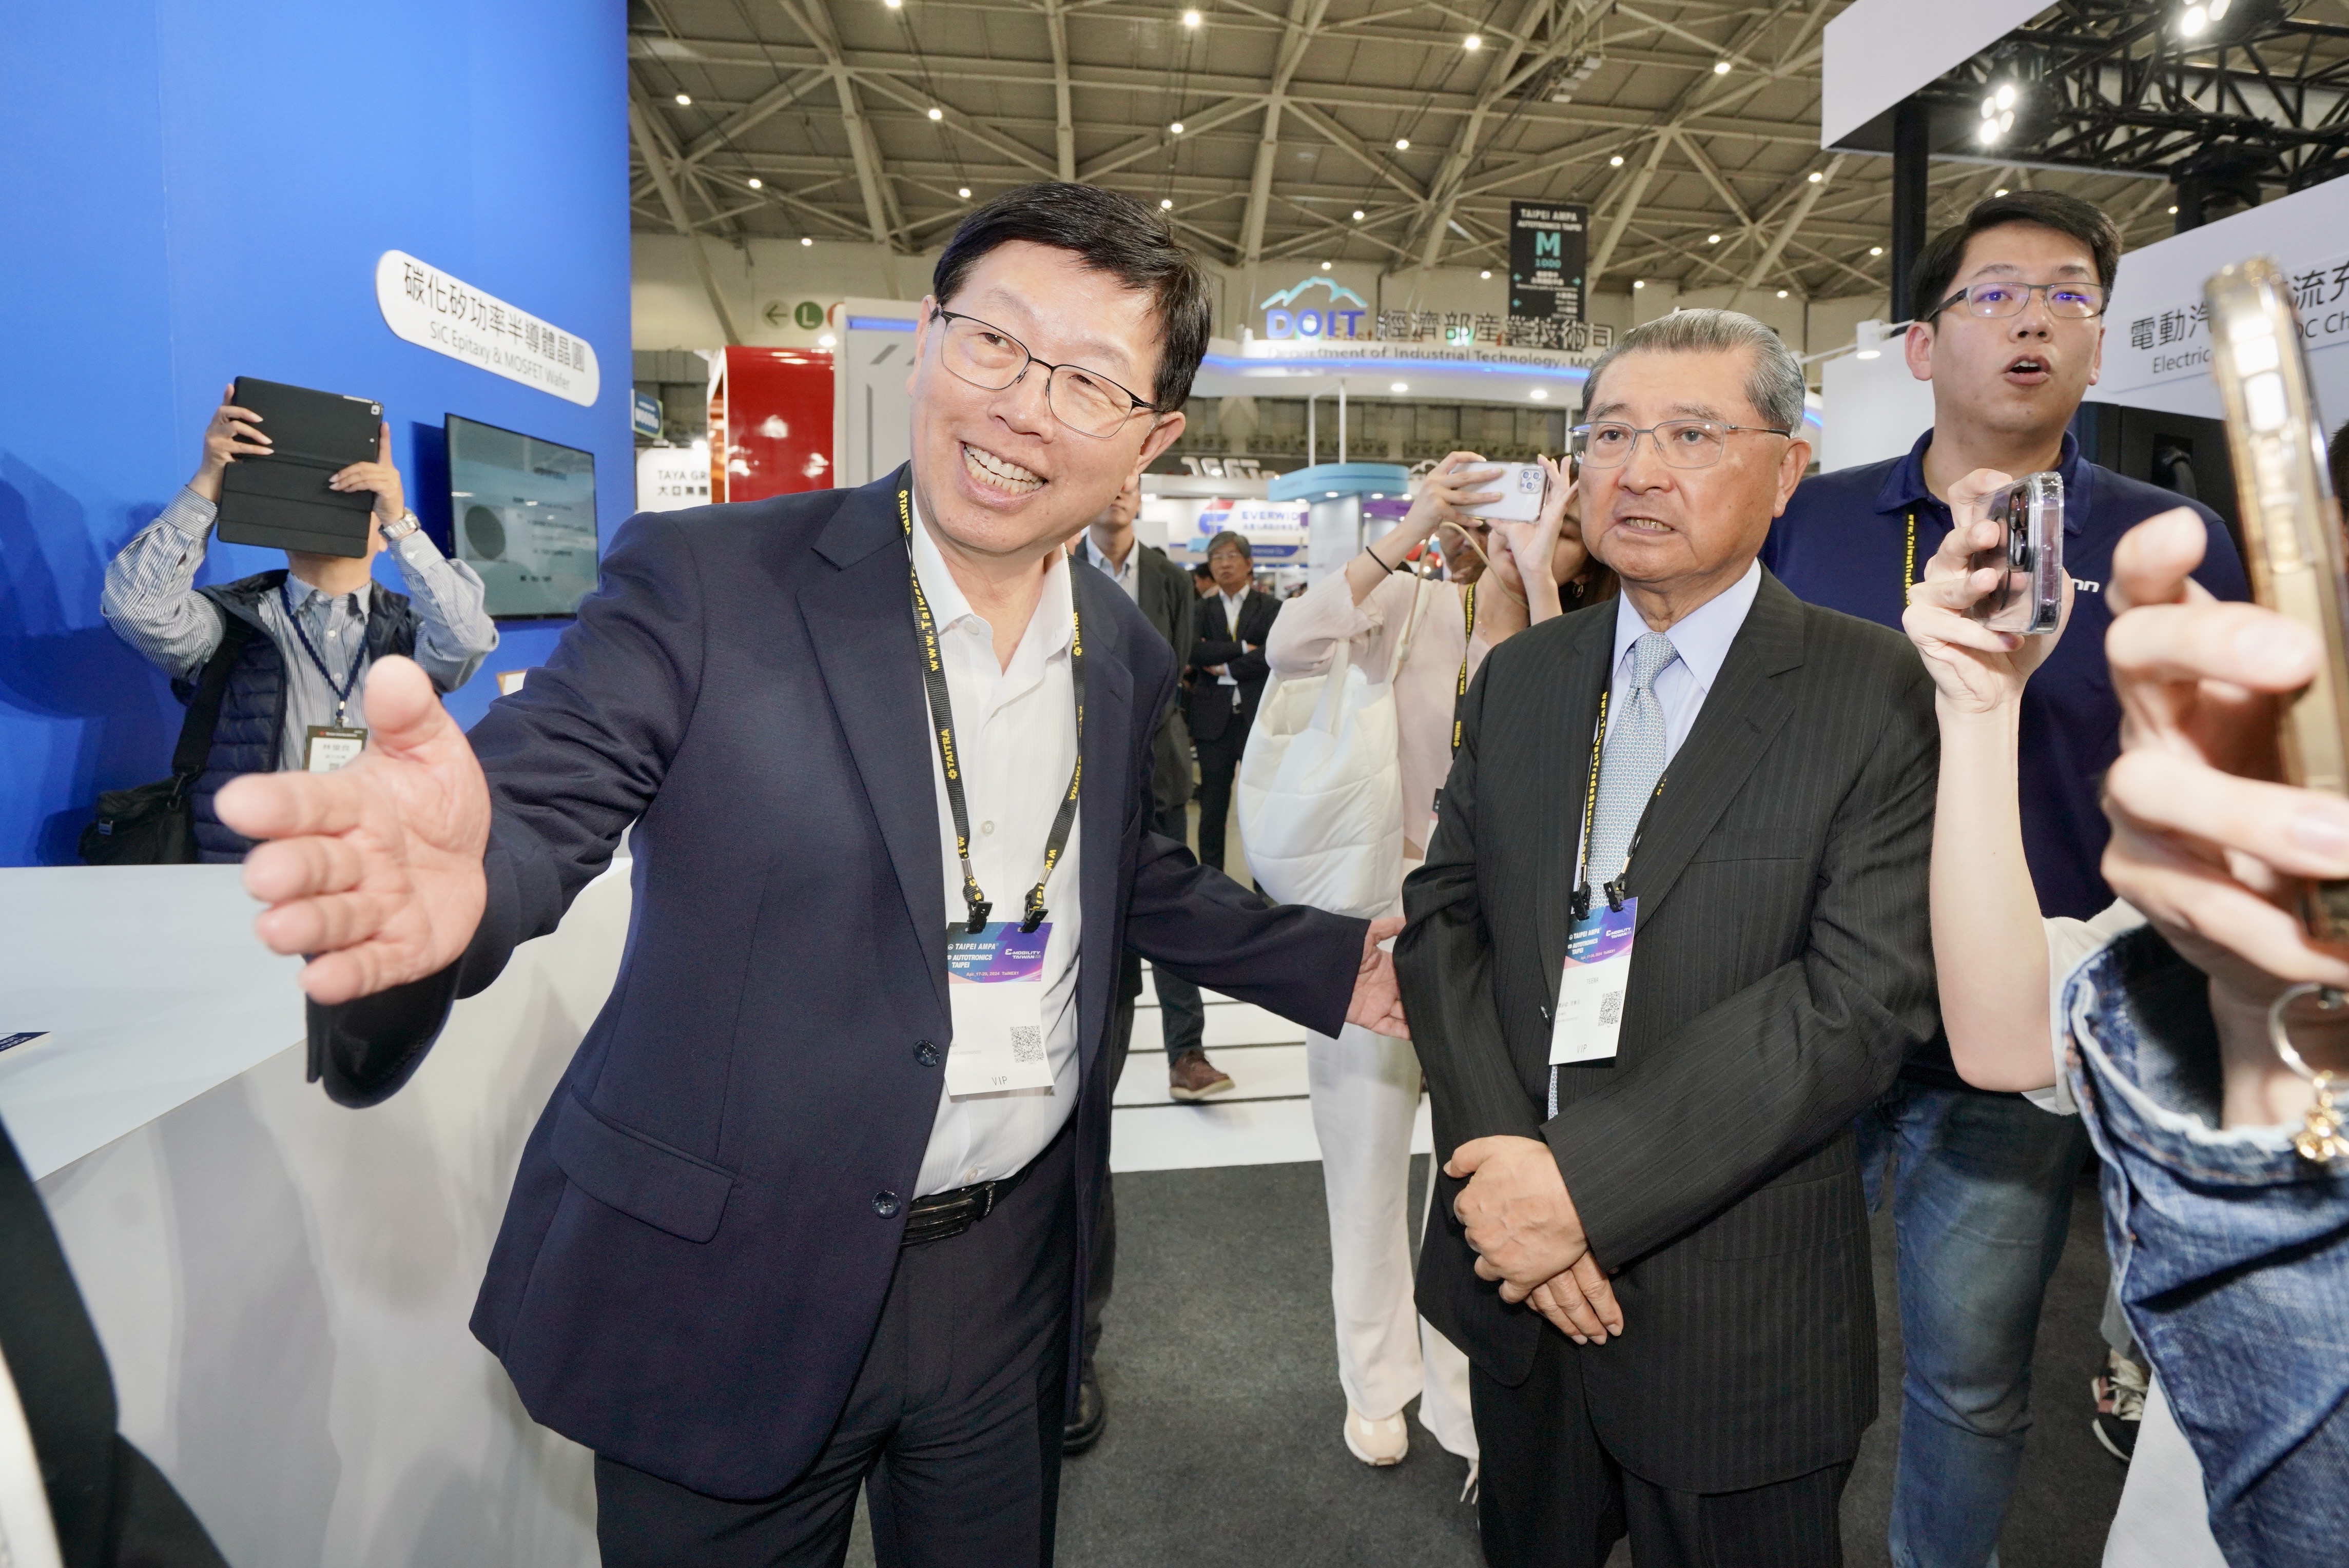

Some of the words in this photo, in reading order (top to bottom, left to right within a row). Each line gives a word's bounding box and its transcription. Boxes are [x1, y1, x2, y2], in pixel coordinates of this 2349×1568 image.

[1535, 231, 1561, 257] M
[403, 261, 585, 374] 碳化矽功率半導體晶圓
[802, 306, 815, 326] L
[1266, 308, 1365, 340] DOIT
[430, 321, 448, 344] SiC
[452, 330, 491, 364] Epitaxy
[504, 351, 542, 380] MOSFET
[1267, 347, 1364, 359] Department
[1370, 346, 1388, 359] of
[1394, 347, 1470, 360] Industrial
[2153, 346, 2210, 374] Electric
[2325, 311, 2349, 334] Ch
[657, 469, 686, 480] TAYA
[691, 470, 709, 480] GR
[899, 497, 911, 536] TAITRA
[1241, 512, 1301, 520] EVERWID
[941, 728, 955, 769] TAITRA
[1573, 931, 1588, 939] TAIPEI
[1577, 1044, 1587, 1053] VIP
[991, 1076, 1008, 1086] VIP
